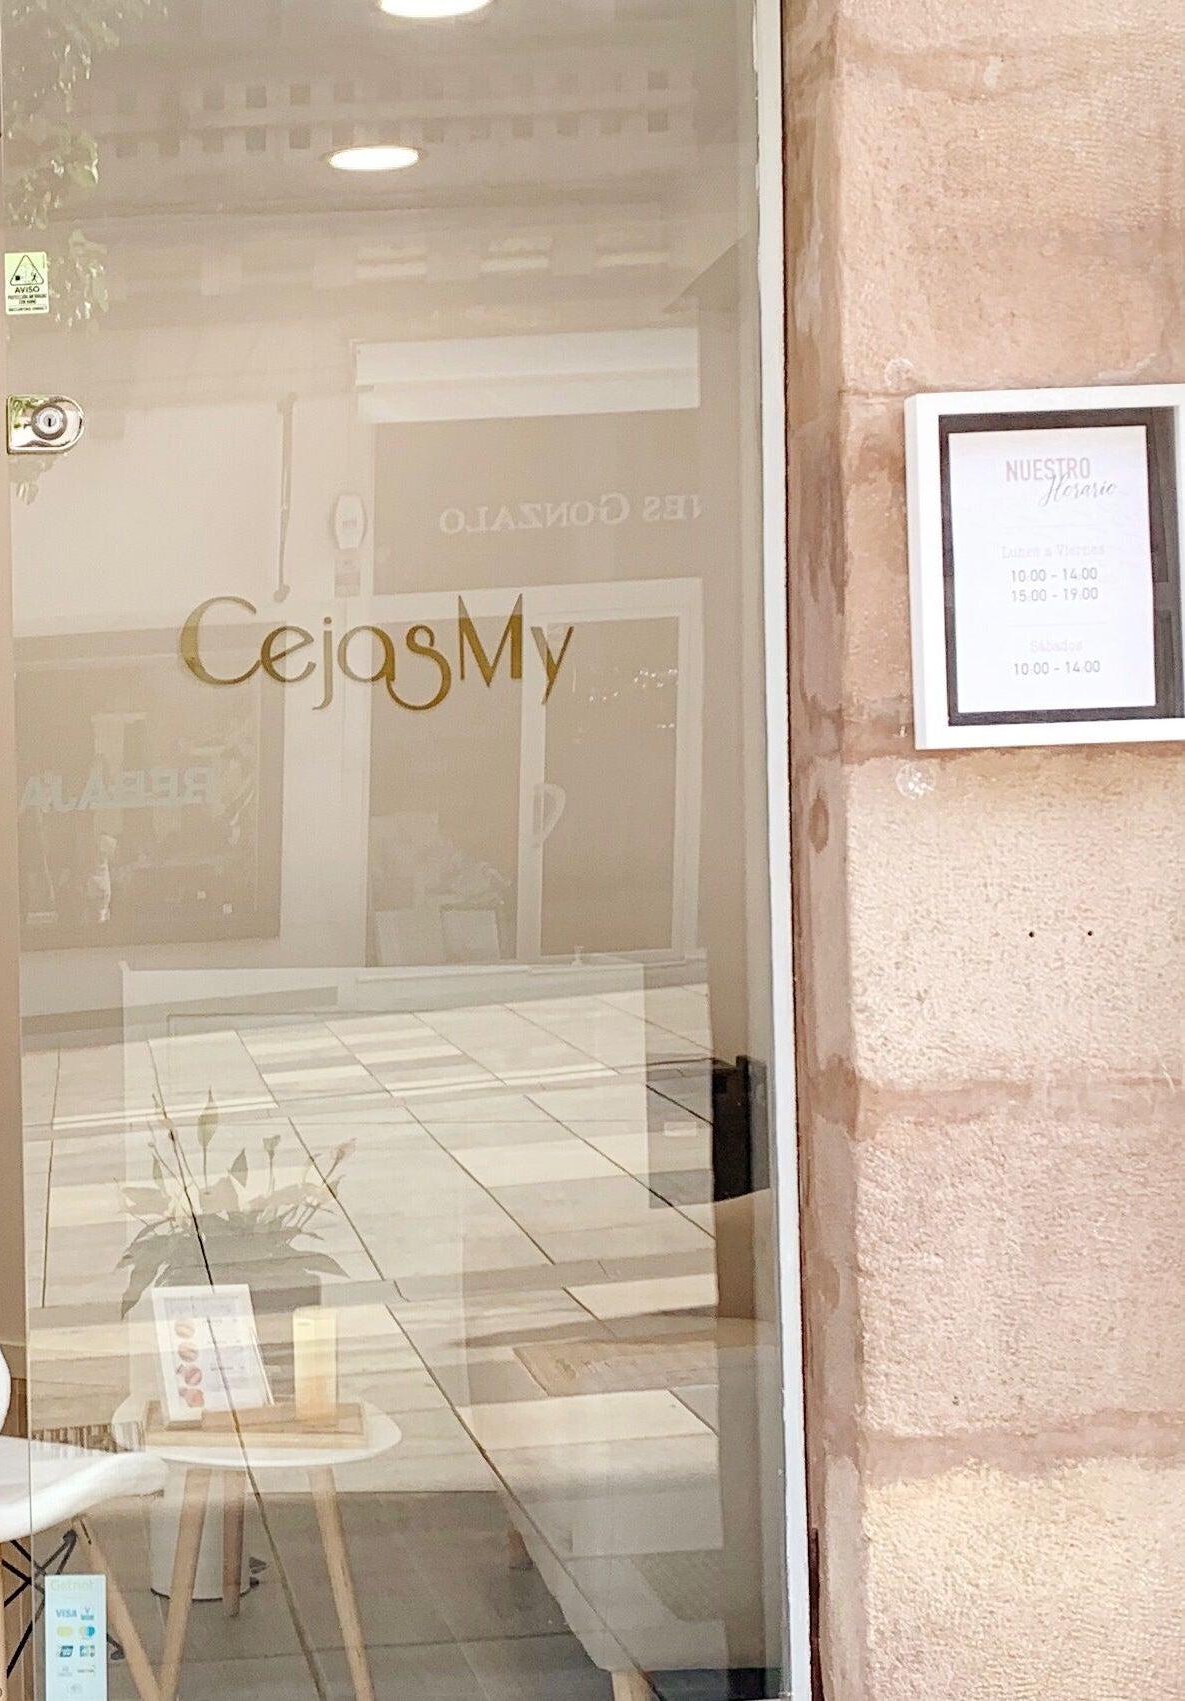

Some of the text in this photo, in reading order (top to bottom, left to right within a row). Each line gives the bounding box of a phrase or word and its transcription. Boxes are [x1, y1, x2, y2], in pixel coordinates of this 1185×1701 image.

[14, 285, 40, 293] AVISO
[1005, 457, 1091, 482] NUESTRO
[1039, 472, 1117, 507] Horario
[180, 593, 575, 711] CejasMy
[55, 1609, 77, 1618] VISA
